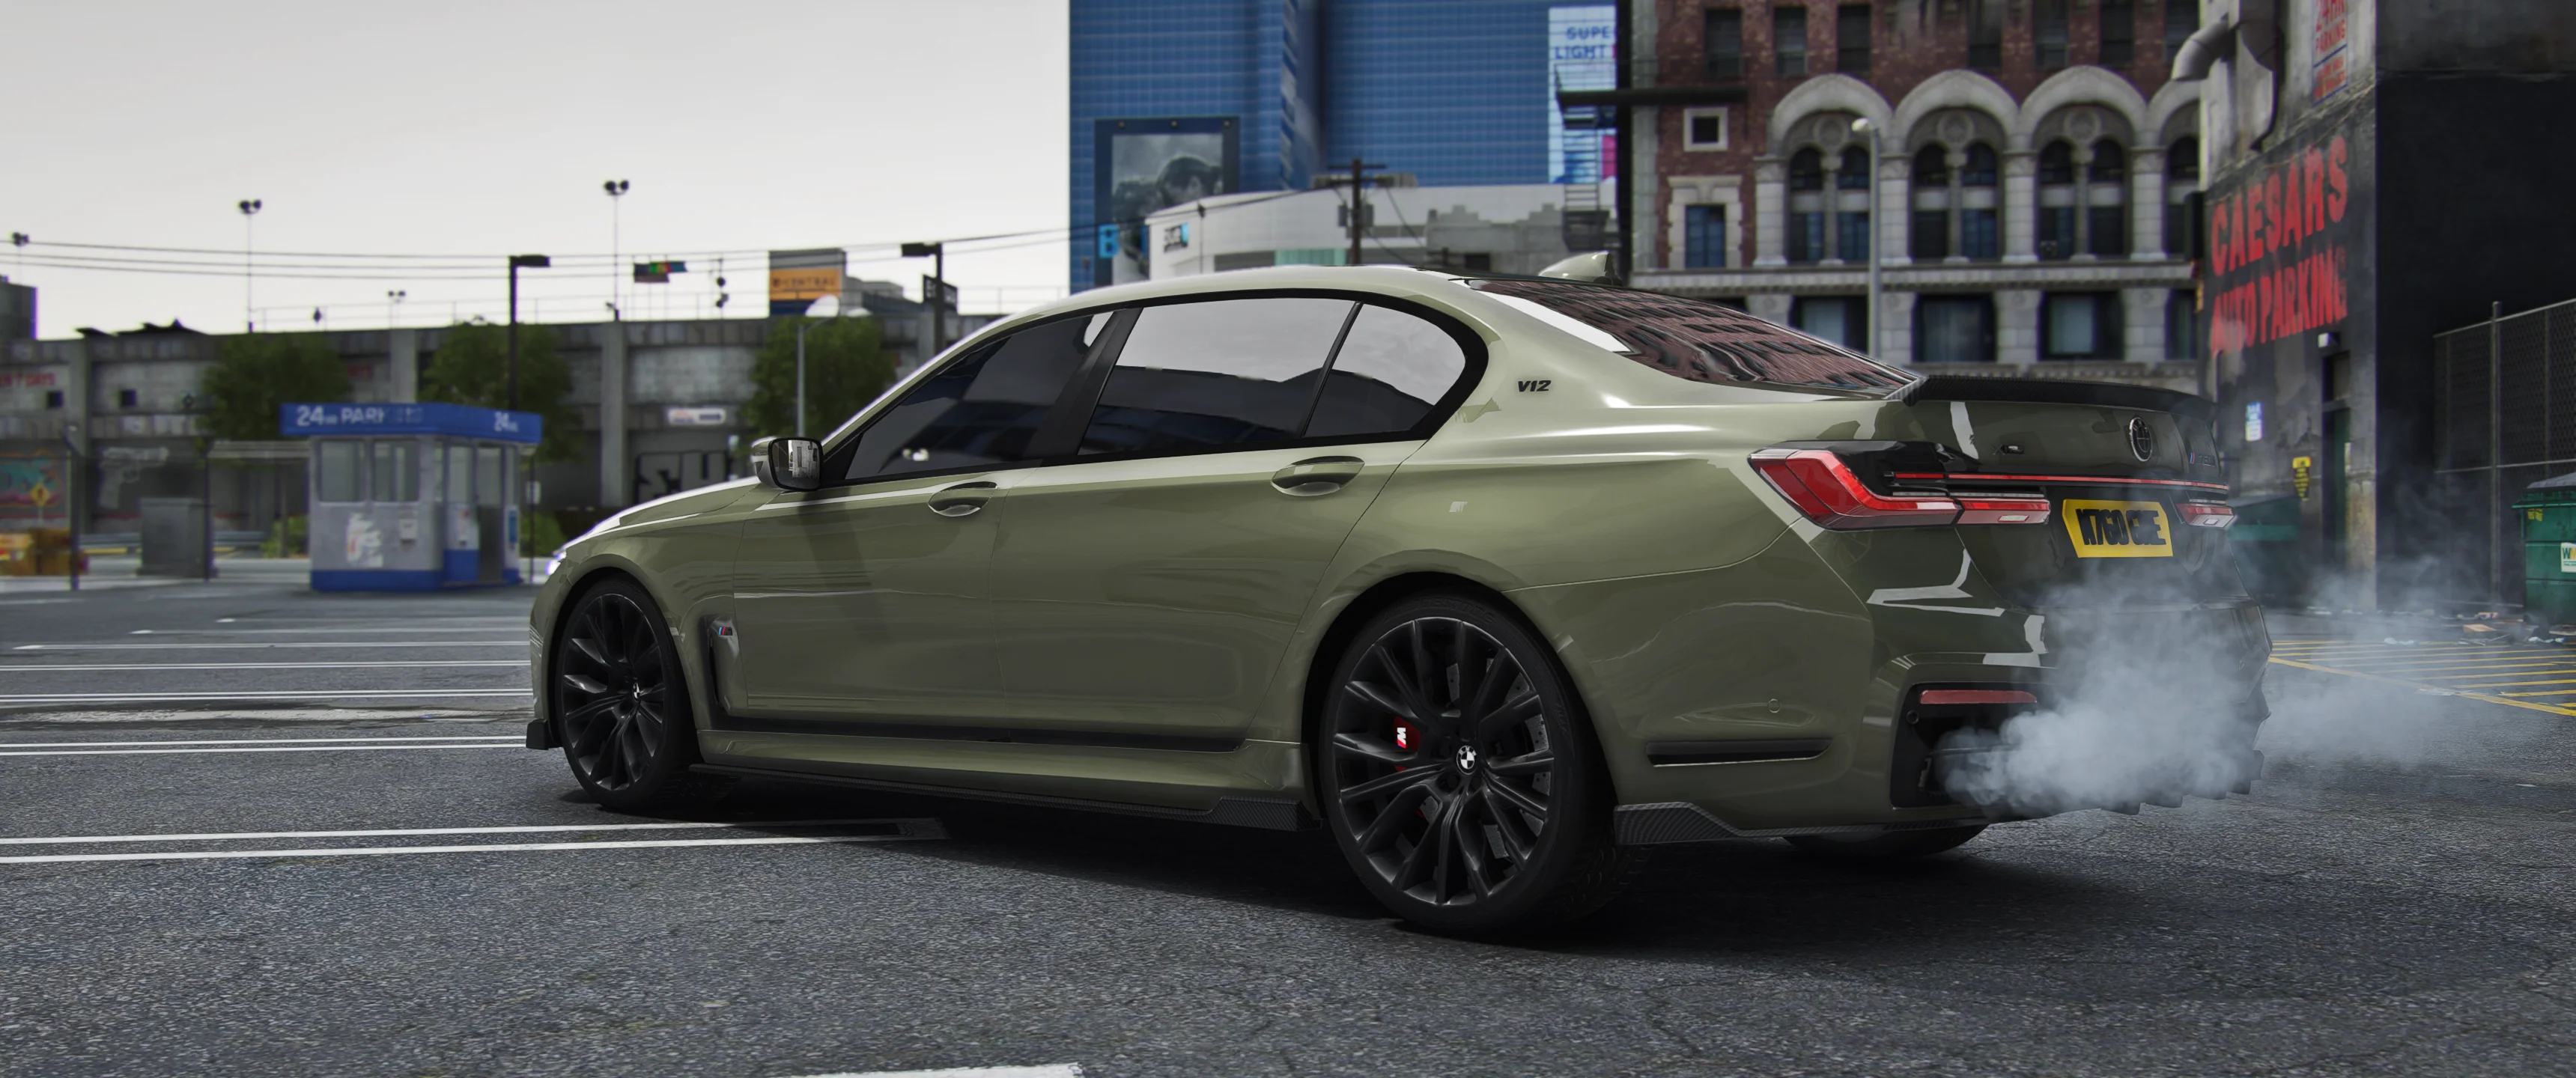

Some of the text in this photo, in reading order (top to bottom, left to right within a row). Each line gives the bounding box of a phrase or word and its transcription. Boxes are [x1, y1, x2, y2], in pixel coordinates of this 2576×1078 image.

[2211, 135, 2348, 277] CAESARS
[2211, 247, 2348, 358] AUTO PARKING
[1518, 380, 1552, 393] V12
